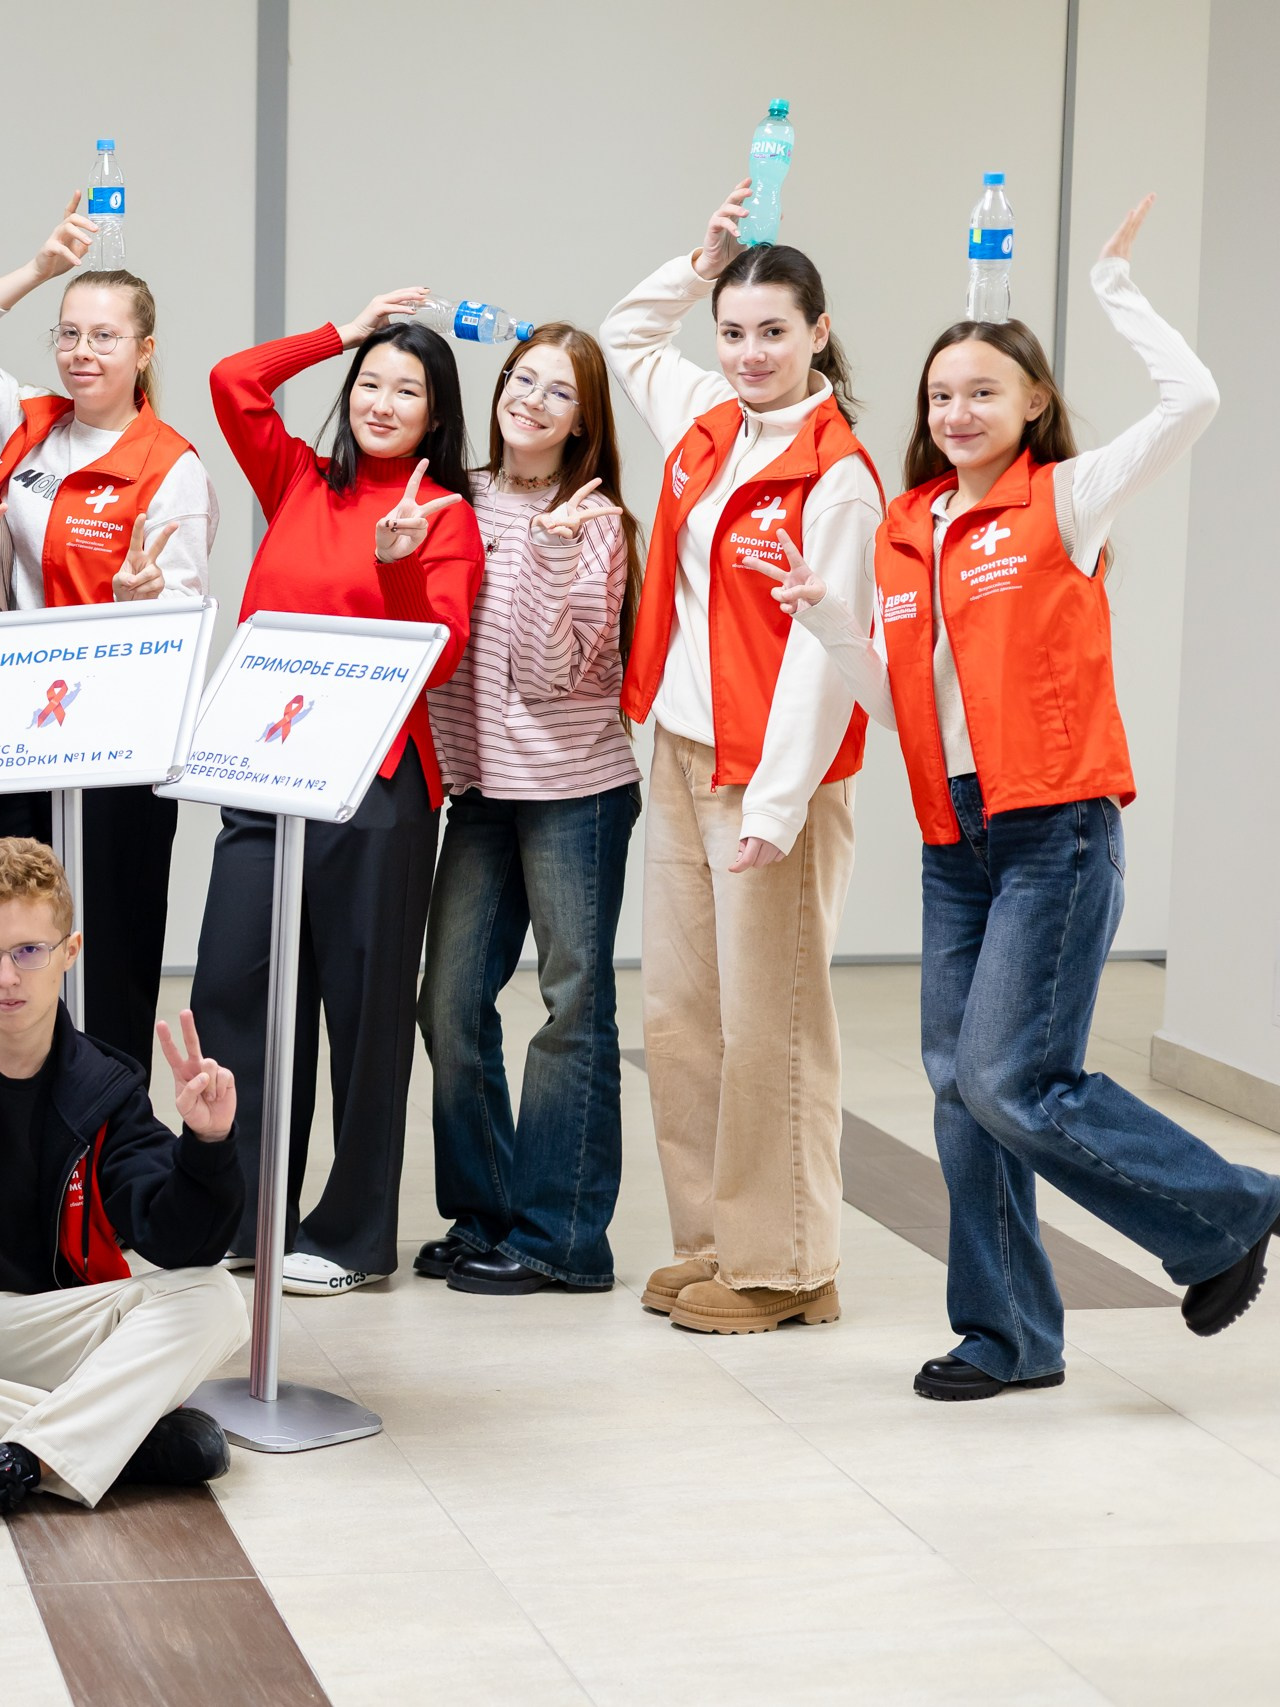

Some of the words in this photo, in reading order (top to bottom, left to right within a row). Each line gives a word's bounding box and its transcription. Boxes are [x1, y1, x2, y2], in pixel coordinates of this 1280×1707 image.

[751, 141, 787, 156] RINK
[66, 515, 123, 532] Волонтеры
[70, 526, 112, 540] медики
[730, 533, 784, 552] Волонтер
[736, 546, 782, 560] медики
[960, 554, 1027, 581] Волонтеры
[970, 566, 1017, 586] медики
[885, 591, 918, 608] ДВФУ
[93, 642, 133, 659] БЕЗ
[138, 638, 184, 656] ВИЧ
[240, 655, 335, 677] ПРИМОРЬЕ
[334, 662, 369, 679] БЕЗ
[369, 665, 410, 683] ВИЧ
[15, 743, 29, 754] В,
[63, 751, 85, 763] №1
[91, 751, 101, 761] И
[107, 749, 133, 761] №2
[190, 751, 239, 767] КОРПУС
[240, 756, 251, 769] В,
[271, 774, 291, 787] №1
[292, 778, 303, 788] И
[305, 779, 327, 791] №2
[329, 1271, 367, 1289] crocs
